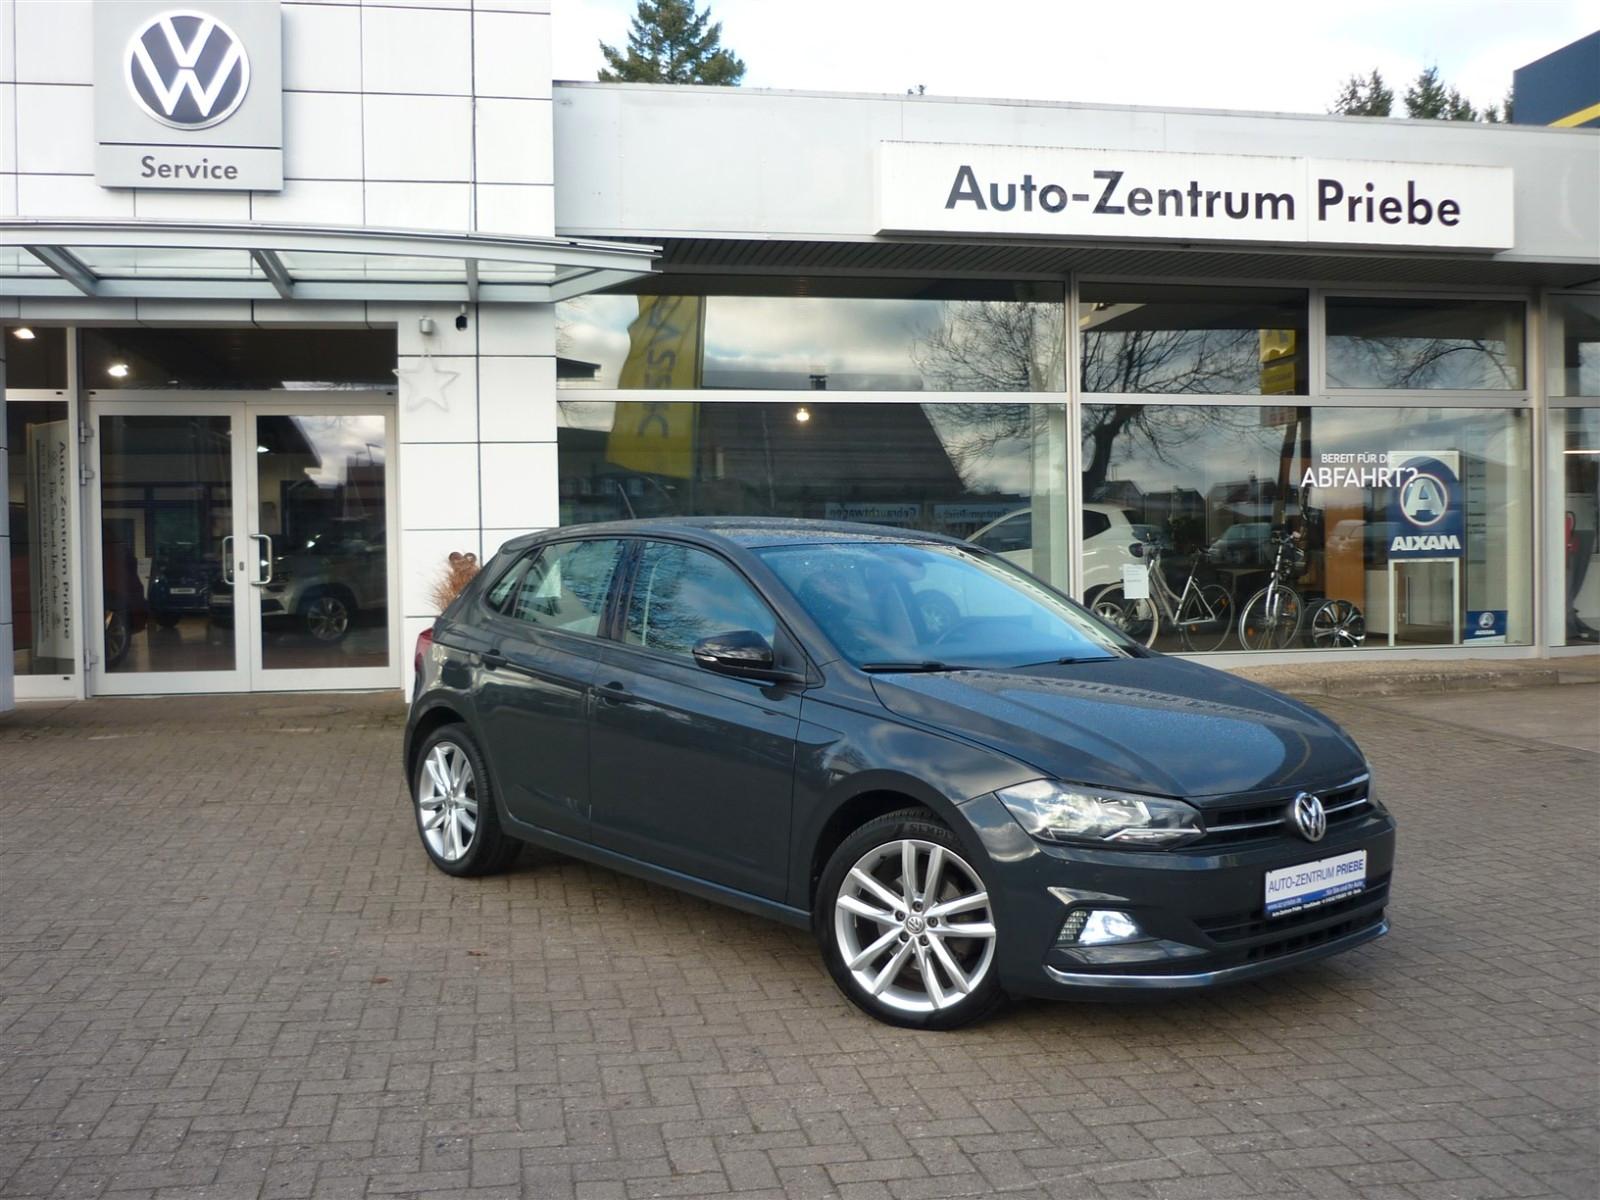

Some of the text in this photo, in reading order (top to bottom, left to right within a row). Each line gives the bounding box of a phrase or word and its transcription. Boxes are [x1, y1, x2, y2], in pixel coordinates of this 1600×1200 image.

[141, 155, 239, 180] Service
[944, 165, 1462, 227] Auto-Zentrum Priebe
[1321, 454, 1355, 464] BEREIT
[1357, 452, 1377, 464] FÜR
[1301, 467, 1418, 488] ABFAHRT?
[1390, 535, 1462, 551] AIXAM
[1268, 867, 1335, 893] AUTO-ZENTRUM
[1336, 859, 1364, 877] PRIEBE
